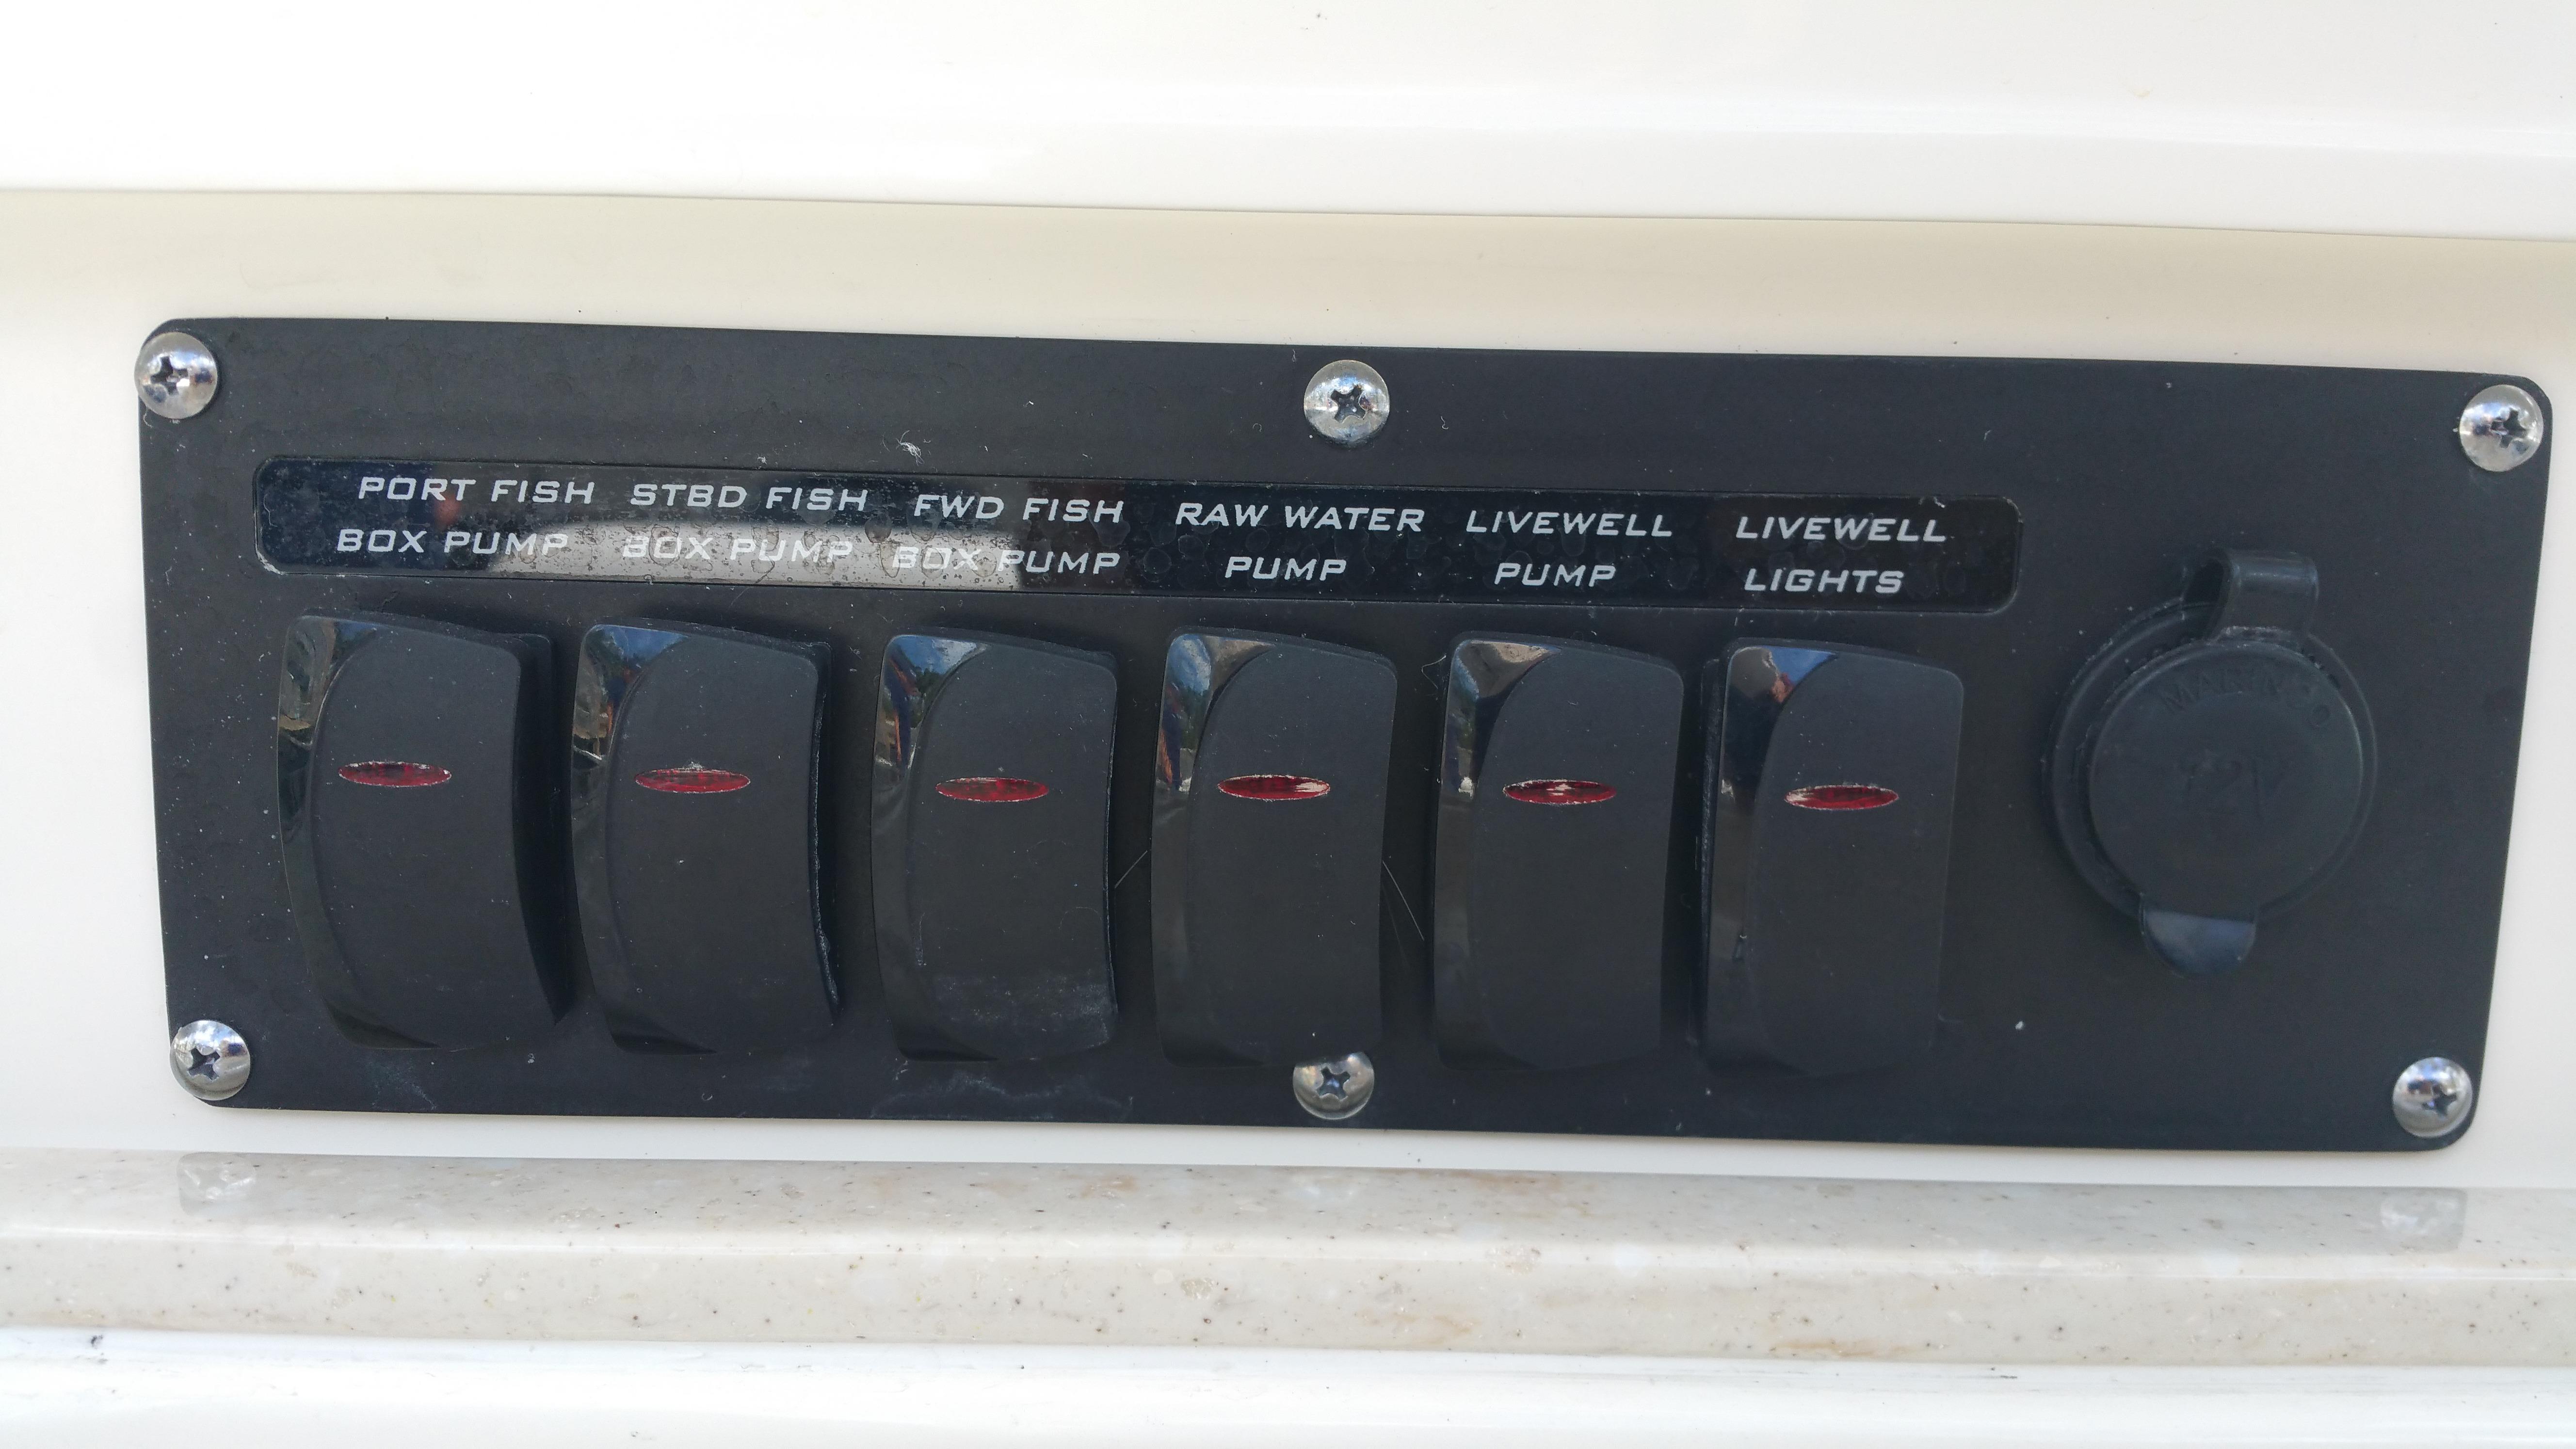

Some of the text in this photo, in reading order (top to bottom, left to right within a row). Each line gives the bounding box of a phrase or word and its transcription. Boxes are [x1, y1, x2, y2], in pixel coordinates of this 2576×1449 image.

[359, 476, 595, 505] PORT FISH
[630, 483, 868, 513] STBD FISH
[913, 493, 1125, 524] FWD FISH
[1175, 502, 1425, 532] RAW WATER
[1466, 512, 1674, 537] LIVEWELL
[1736, 515, 1947, 542] LIVEWELL
[337, 528, 571, 557] BOX PUMP
[622, 535, 854, 564] BOX PUMP
[892, 546, 1121, 575] BOX PUMP
[1225, 556, 1346, 580] PUMP
[1494, 563, 1616, 587] PUMP
[1745, 568, 1903, 594] LIGHTS
